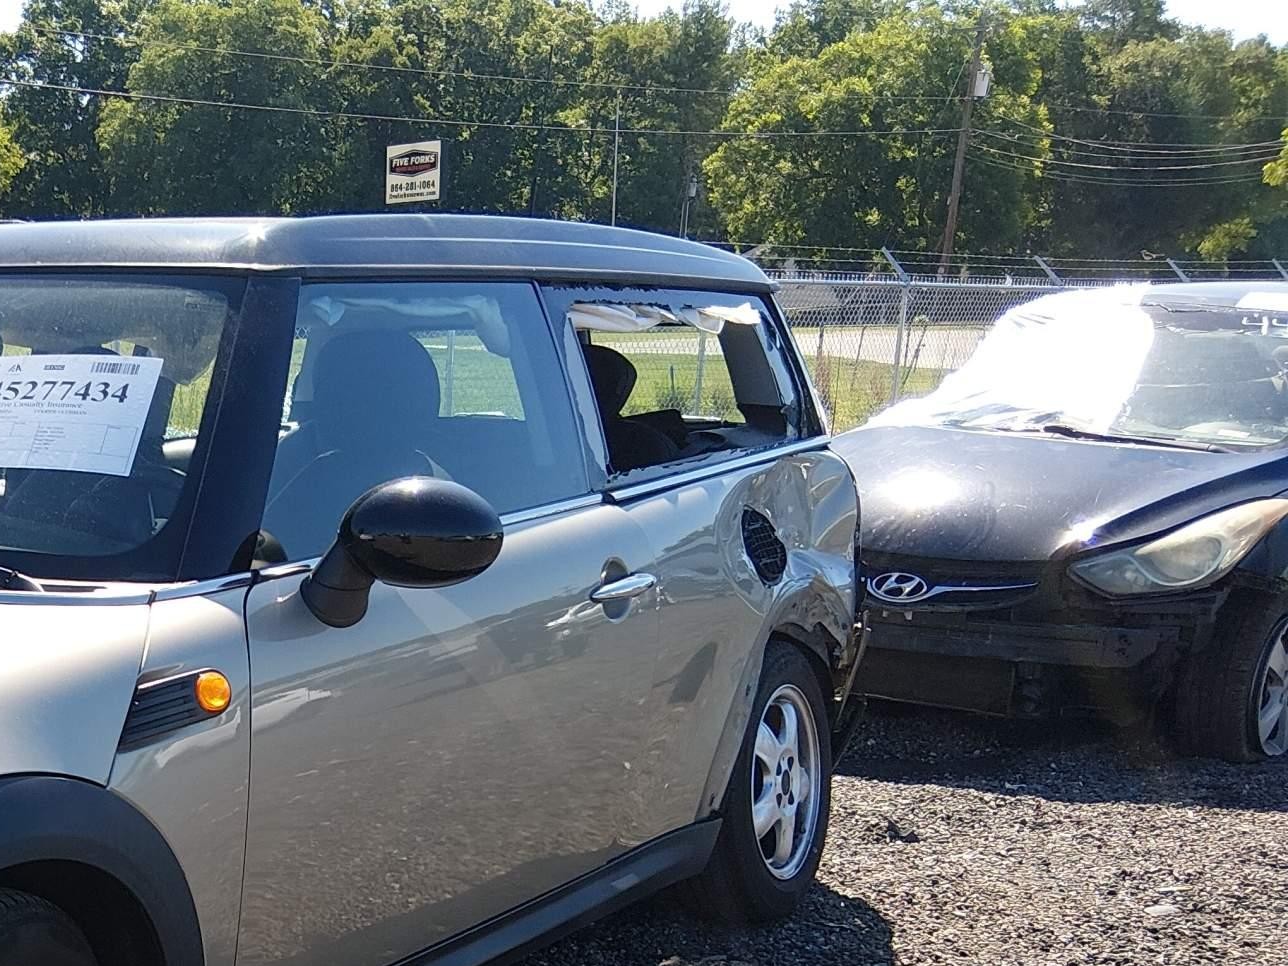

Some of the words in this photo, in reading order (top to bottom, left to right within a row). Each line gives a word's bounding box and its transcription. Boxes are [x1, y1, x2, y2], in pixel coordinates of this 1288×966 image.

[392, 158, 409, 168] FIVE
[410, 155, 435, 165] FORKS
[391, 180, 435, 192] 864-281-1064
[47, 401, 83, 409] Insurance
